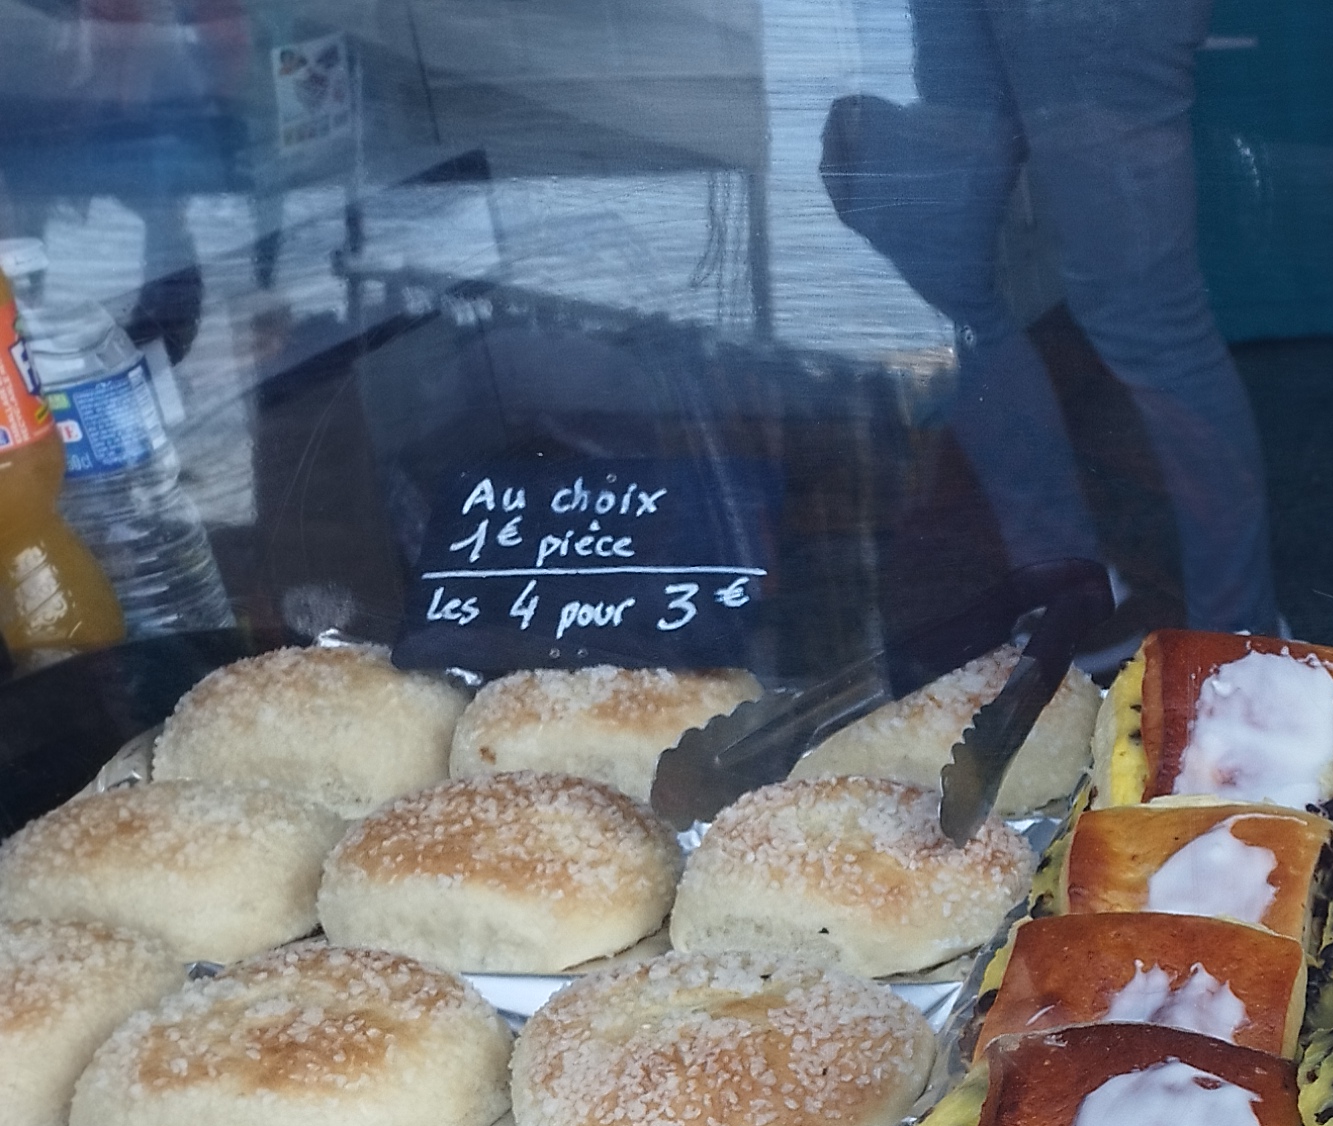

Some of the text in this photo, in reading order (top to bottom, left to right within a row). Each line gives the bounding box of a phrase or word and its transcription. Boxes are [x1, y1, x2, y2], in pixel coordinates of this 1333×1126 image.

[462, 476, 669, 517] Au choix
[536, 520, 636, 567] pièce
[509, 579, 540, 631] 4
[556, 597, 636, 640] pour
